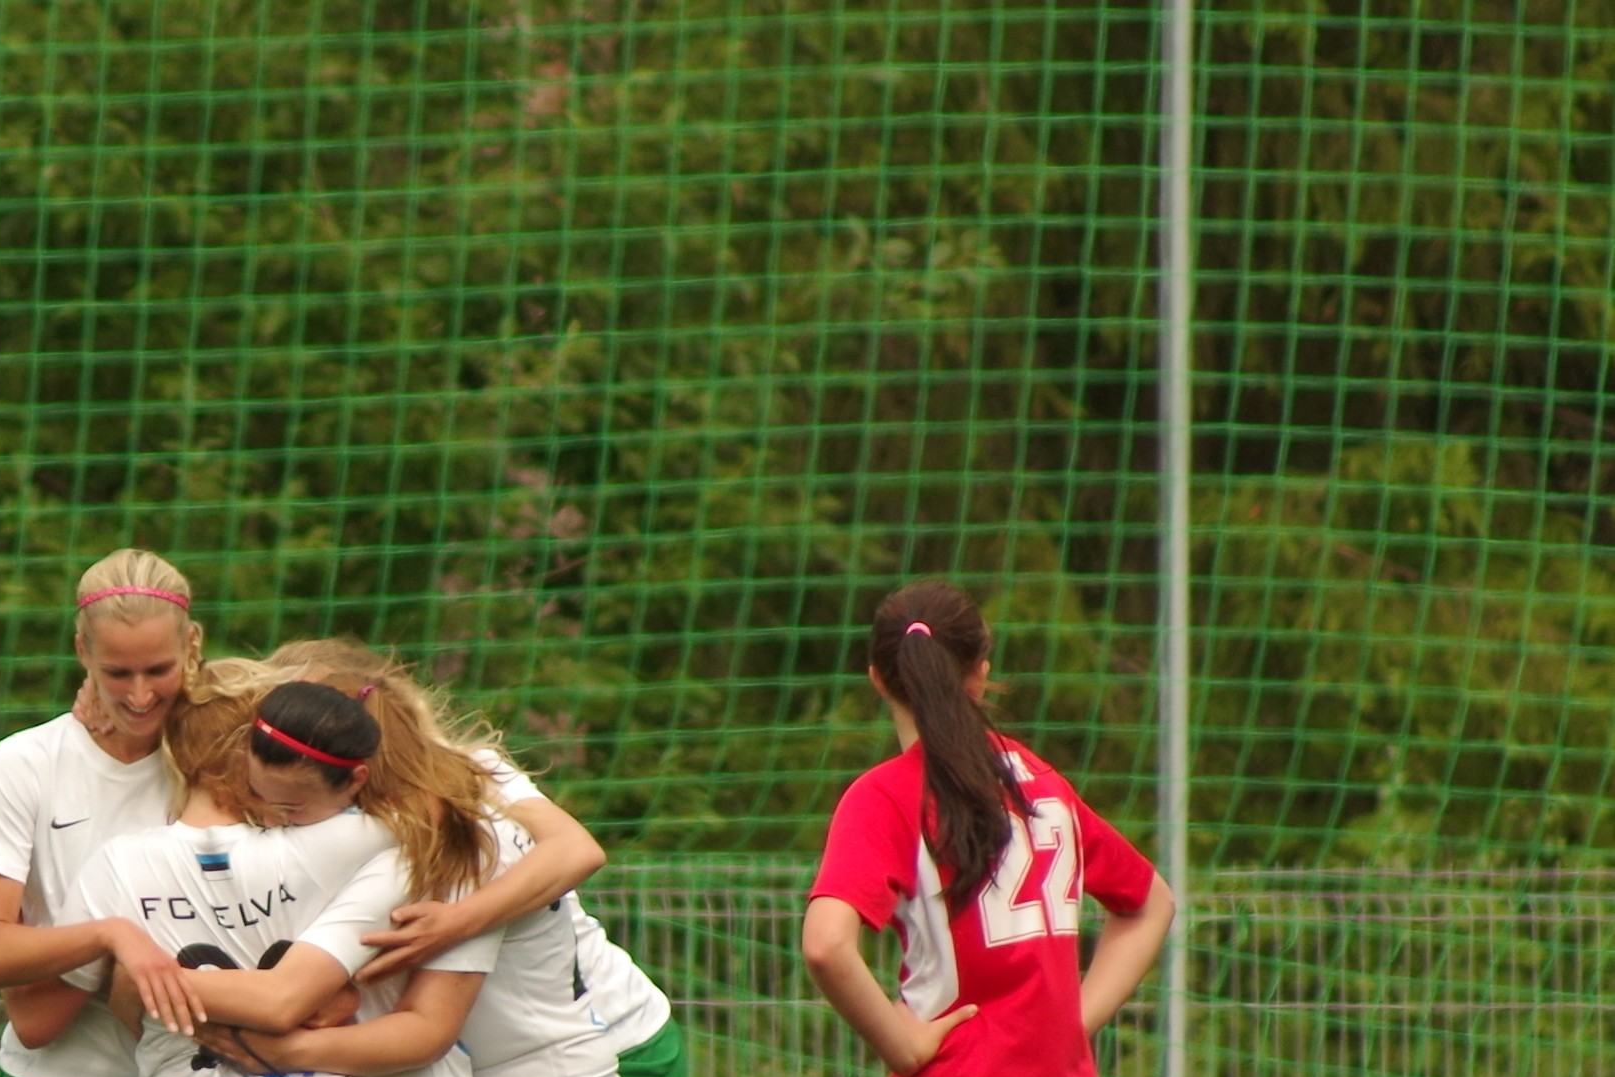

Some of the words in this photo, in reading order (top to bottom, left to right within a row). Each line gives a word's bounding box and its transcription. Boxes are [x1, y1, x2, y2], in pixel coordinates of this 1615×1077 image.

[140, 897, 196, 920] FC
[213, 884, 296, 928] ELVA
[979, 797, 1080, 948] 22
